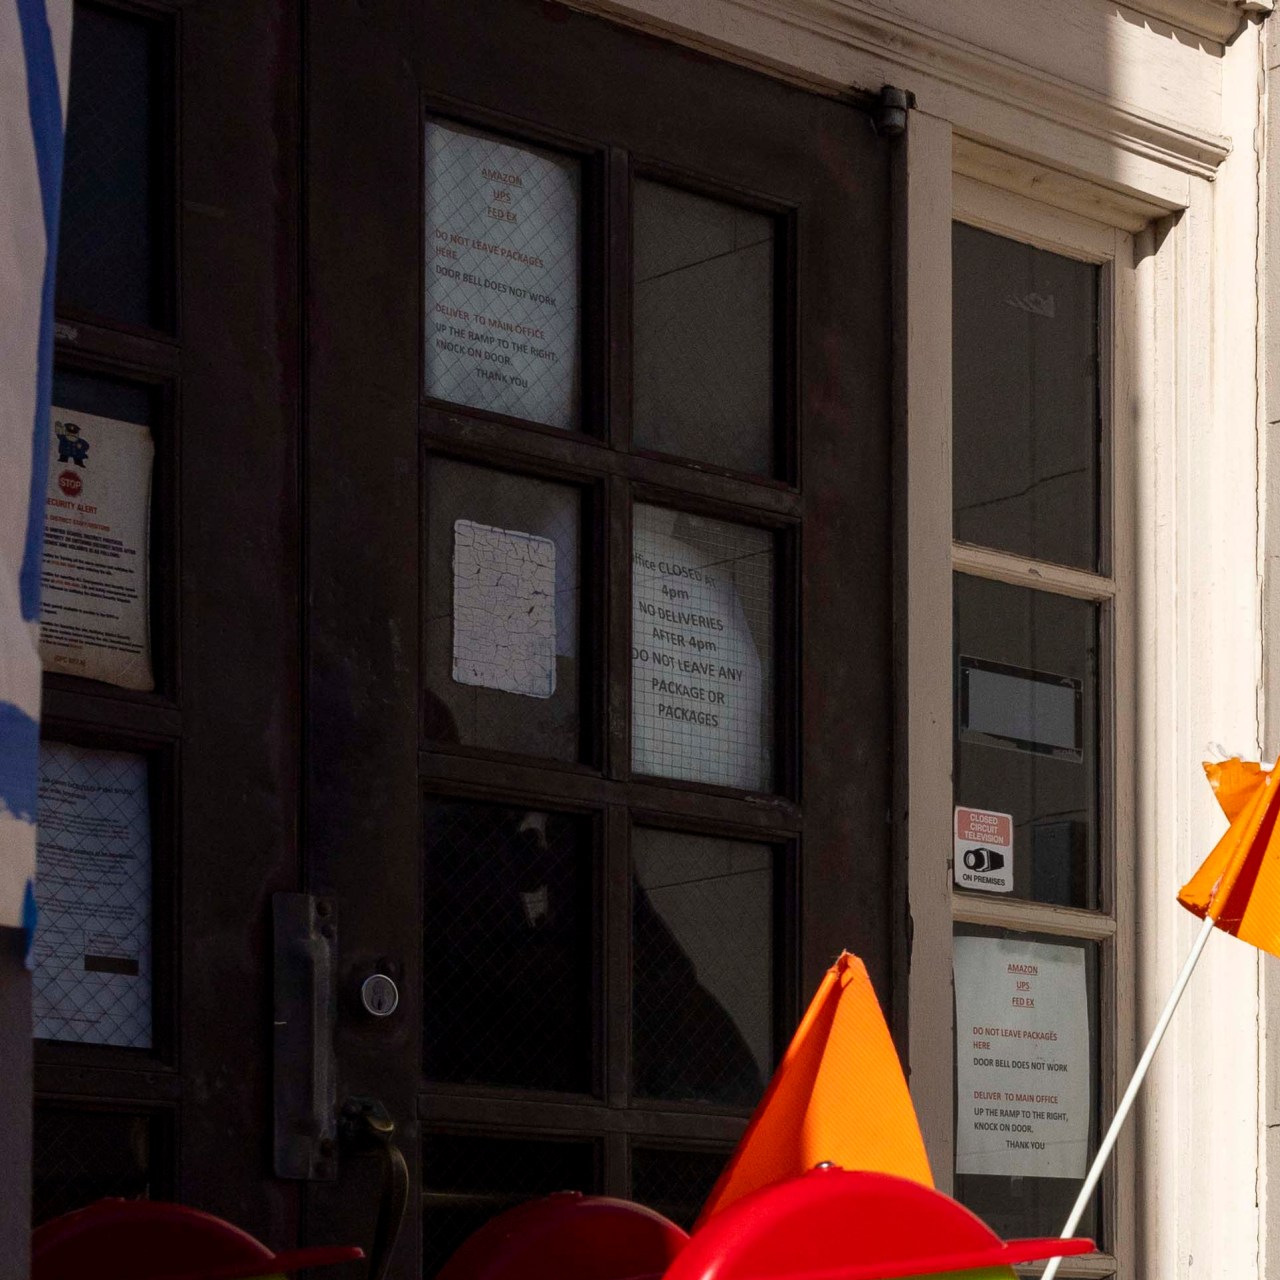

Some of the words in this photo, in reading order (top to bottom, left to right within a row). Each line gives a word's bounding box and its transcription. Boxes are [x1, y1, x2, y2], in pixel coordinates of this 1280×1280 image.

[481, 168, 523, 186] AMAZON
[493, 189, 511, 202] UPS
[77, 503, 97, 515] ALERT
[658, 561, 701, 582] CLOSED
[661, 584, 690, 600] 4pm
[639, 601, 656, 617] NO
[658, 606, 724, 631] DELIVERIES
[652, 627, 685, 647] AFTER
[688, 636, 717, 652] 4pm
[632, 648, 648, 662] DO
[652, 652, 675, 668] NOT
[678, 659, 715, 677] LEAVE
[718, 666, 742, 681] ANY
[651, 677, 705, 701] PACKAGE
[708, 690, 725, 705] OR
[658, 703, 718, 727] PACKAGES
[970, 813, 998, 825] CLOSED
[970, 823, 998, 834] CIRCUIT
[964, 831, 1004, 844] TELEVISION
[962, 873, 972, 881] ON
[973, 875, 1006, 886] PREMISES
[1007, 963, 1038, 975] AMAZON
[1016, 981, 1030, 990] UPS
[1012, 997, 1024, 1006] FED
[1025, 998, 1035, 1007] EX
[973, 1027, 983, 1036] DO
[985, 1028, 999, 1037] NOT
[1001, 1029, 1021, 1039] LEAVE
[1023, 1031, 1058, 1041] PACKAGES
[973, 1041, 991, 1050] HERE
[974, 1057, 994, 1067] DOOR
[996, 1059, 1010, 1069] BELL
[1012, 1061, 1030, 1070] DOES
[1031, 1062, 1045, 1071] NOT
[1047, 1063, 1068, 1072] WORK
[974, 1091, 1001, 1101] DELIVER
[1004, 1092, 1014, 1102] TO
[1015, 1093, 1035, 1102] MAIN
[1036, 1094, 1058, 1104] OFFICE
[974, 1107, 984, 1117] UP
[985, 1108, 998, 1117] THE
[1000, 1109, 1020, 1118] RAMP
[1021, 1110, 1031, 1119] TO
[1032, 1111, 1045, 1120] THE
[1046, 1112, 1068, 1122] RIGHT,
[974, 1122, 998, 1131] KNOCK
[1000, 1123, 1010, 1132] ON
[1012, 1124, 1034, 1133] DOOR.
[1006, 1140, 1030, 1149] THANK
[1031, 1141, 1045, 1150] YOU
